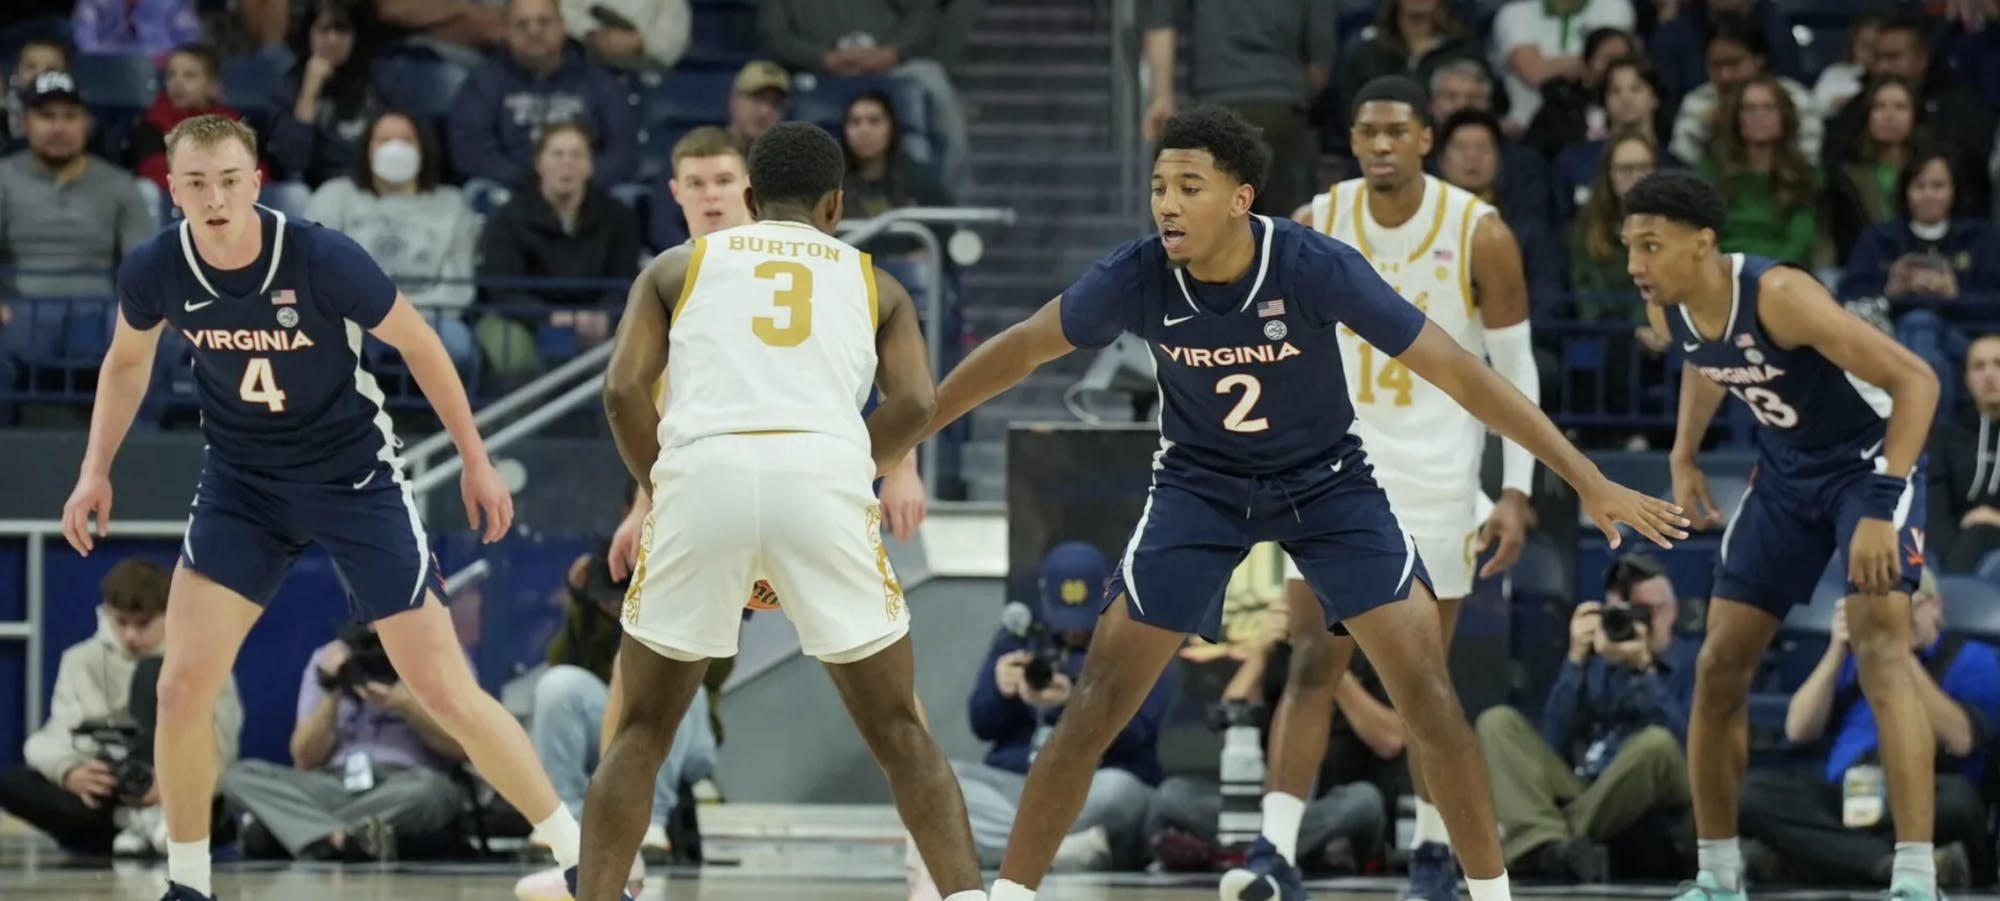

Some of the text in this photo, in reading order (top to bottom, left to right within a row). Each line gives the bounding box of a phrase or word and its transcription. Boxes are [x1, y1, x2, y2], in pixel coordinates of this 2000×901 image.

[728, 235, 841, 262] BURTON
[751, 260, 813, 348] 3
[182, 328, 315, 351] VIRGINIA
[1159, 341, 1301, 367] VIRGINIA
[239, 357, 286, 412] 4
[1357, 342, 1414, 407] 14
[1215, 373, 1269, 432] 2
